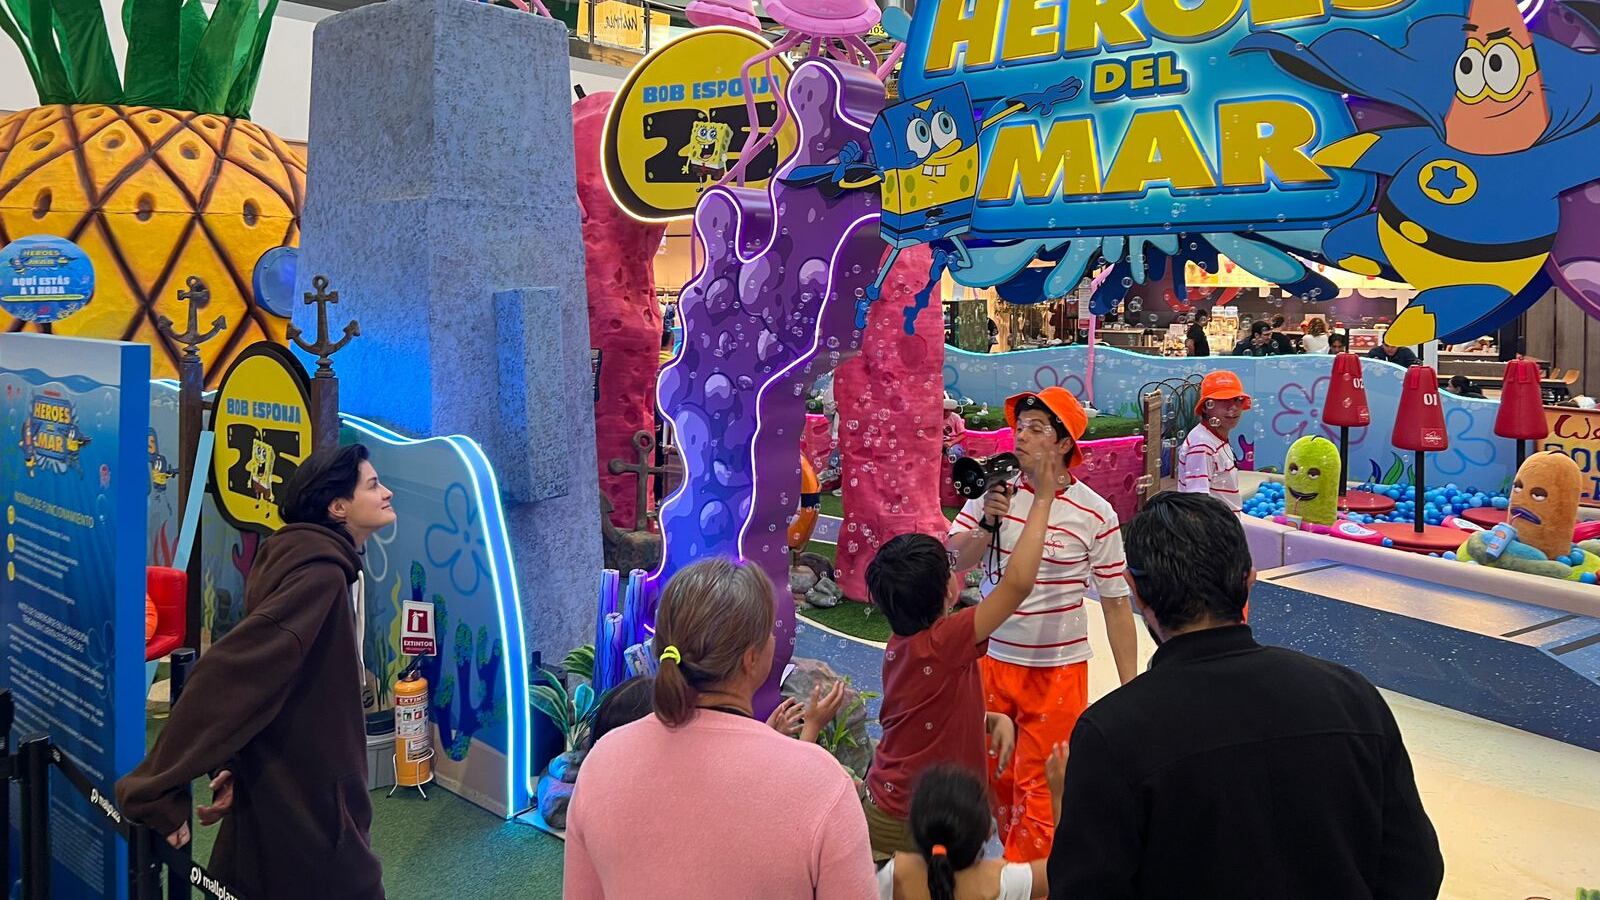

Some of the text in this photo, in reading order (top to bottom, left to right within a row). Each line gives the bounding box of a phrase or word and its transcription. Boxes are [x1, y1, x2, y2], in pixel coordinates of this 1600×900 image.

[925, 0, 1402, 72] HER
[1093, 56, 1183, 94] DEL
[642, 84, 685, 103] BOB
[642, 101, 779, 183] 25
[978, 101, 1334, 201] MAR
[12, 274, 71, 286] AQUÍ ESTÁS
[20, 286, 65, 295] A 1 HORA
[226, 398, 302, 424] BOB ESPONJA
[1423, 393, 1438, 406] 01
[33, 401, 72, 424] HEROES
[36, 431, 64, 453] MAR
[203, 875, 239, 900] mallpla
